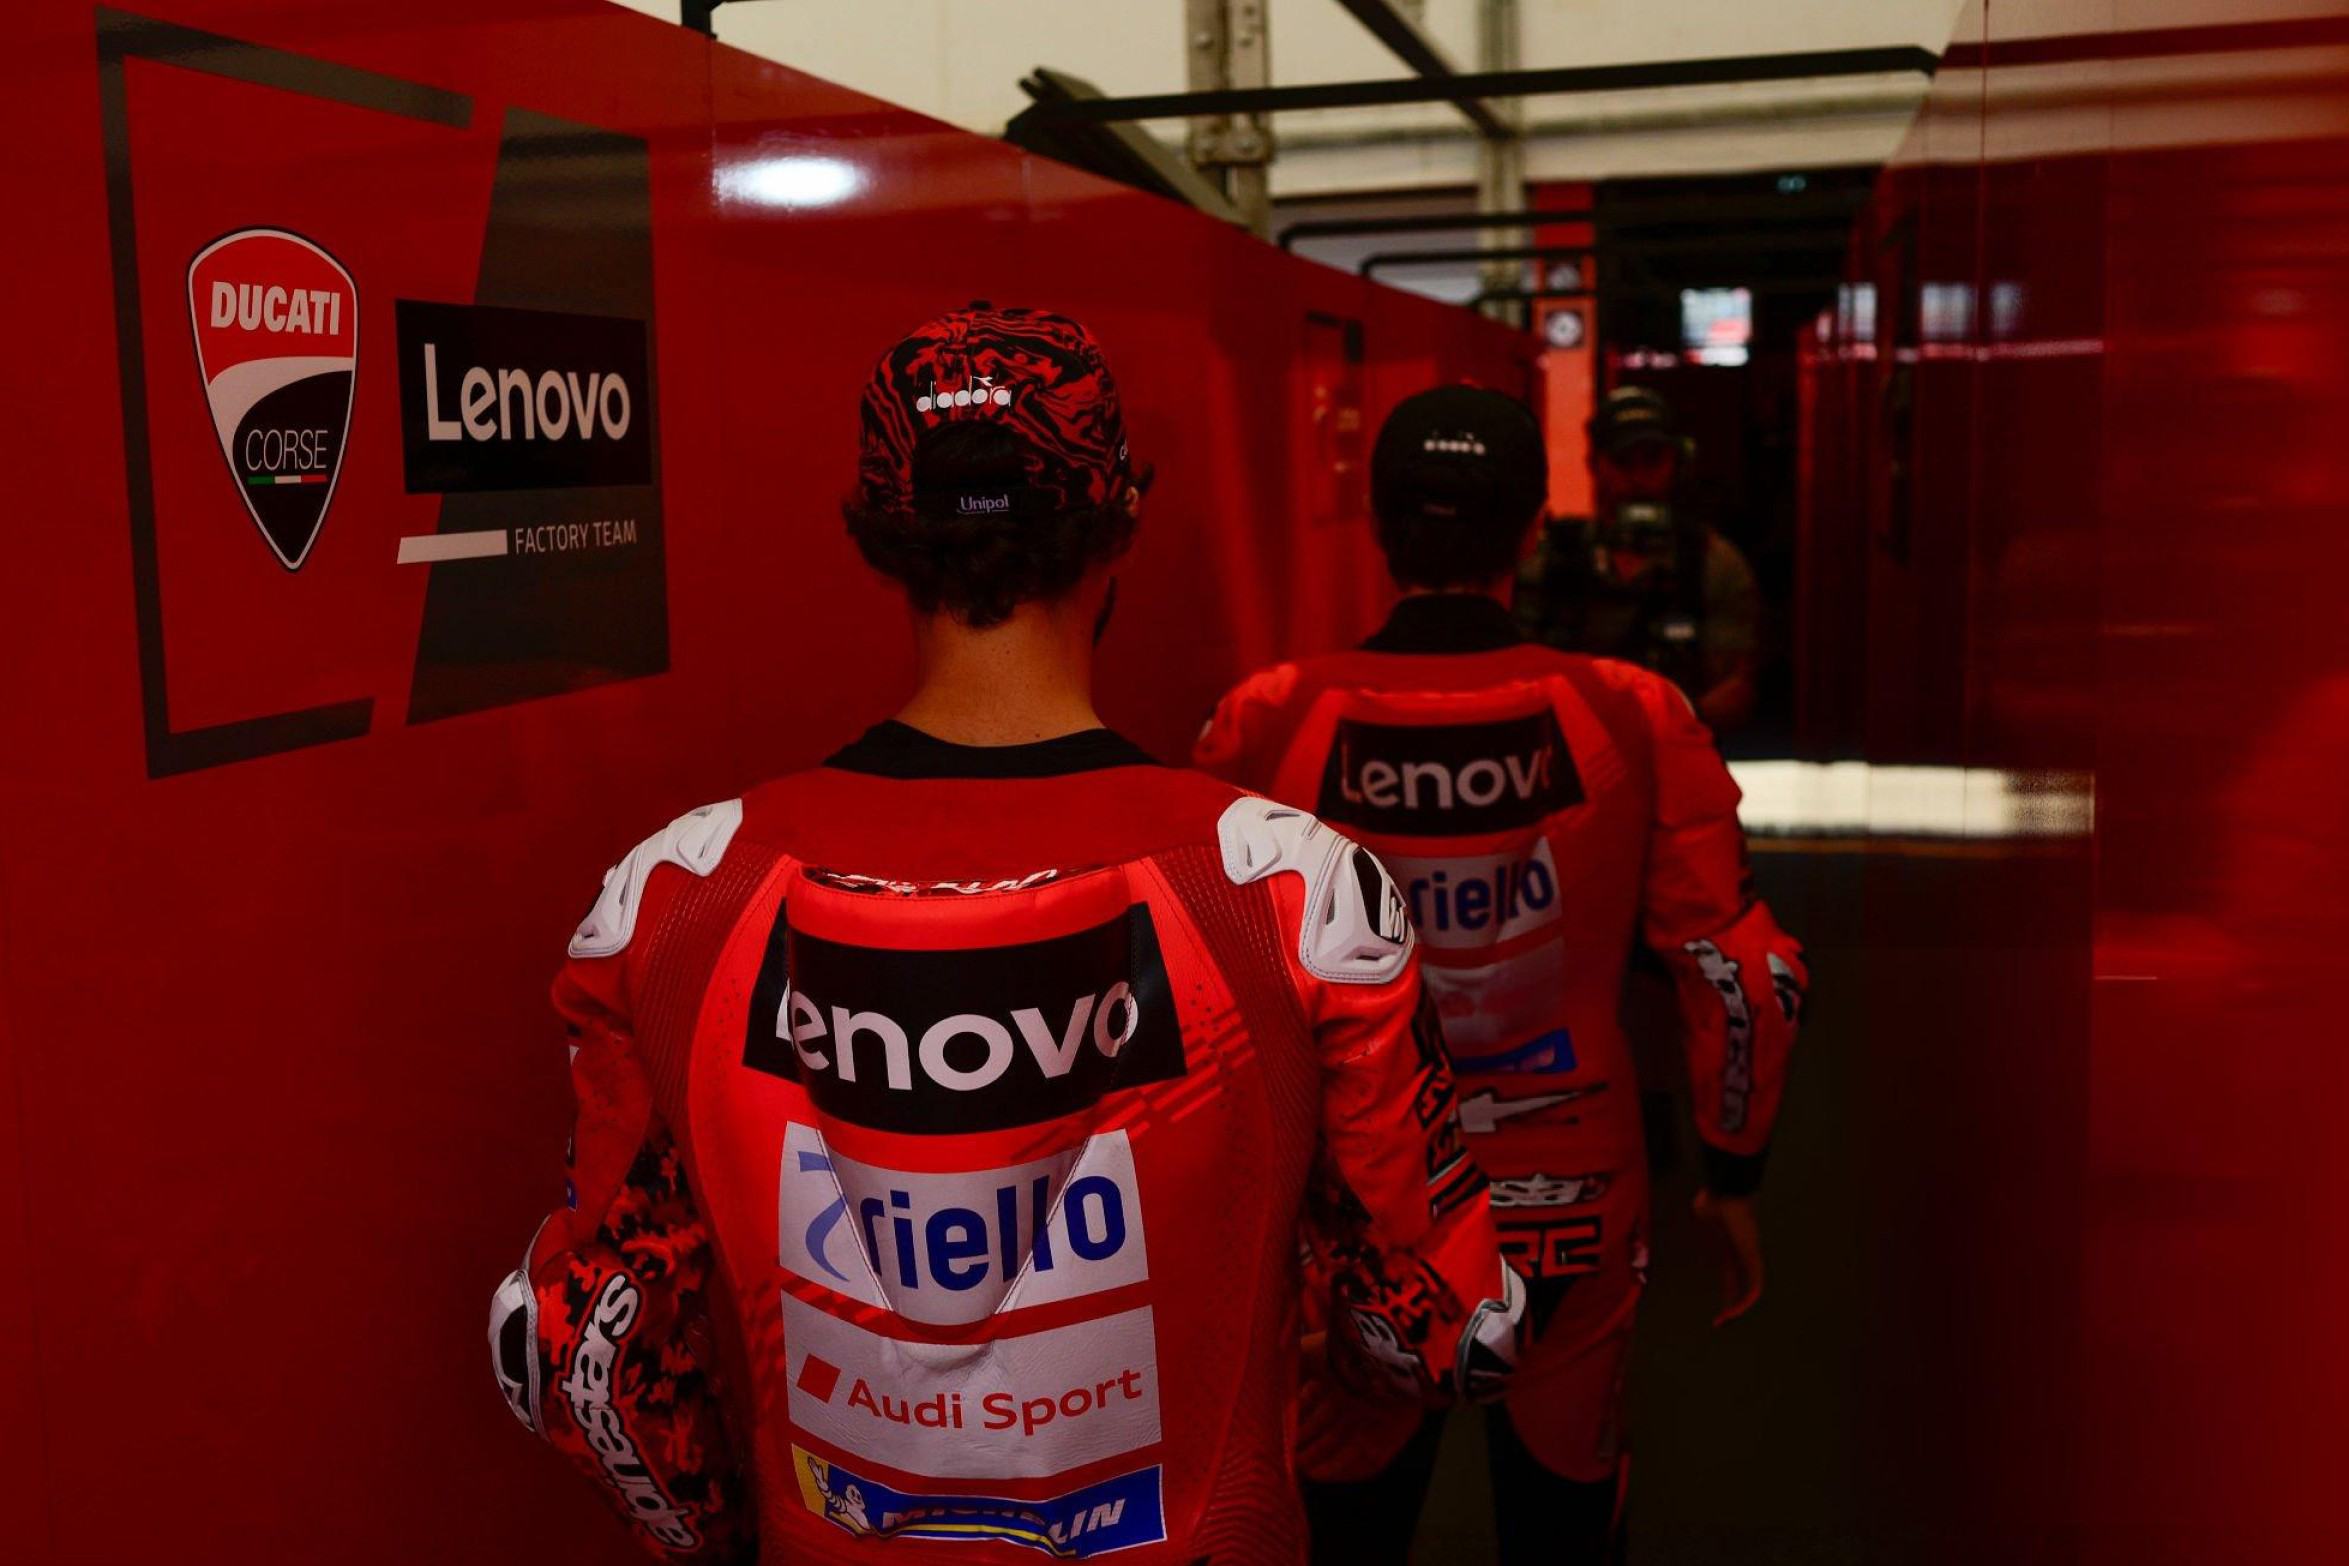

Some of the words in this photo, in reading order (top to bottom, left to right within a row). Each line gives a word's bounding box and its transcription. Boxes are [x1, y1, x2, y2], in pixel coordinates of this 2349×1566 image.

[210, 281, 341, 336] DUCATI
[424, 342, 632, 442] Lenovo
[245, 428, 329, 471] CORSE
[960, 494, 1009, 514] Unipol
[514, 524, 589, 555] FACTORY
[594, 519, 638, 548] TEAM
[859, 1175, 1127, 1292] riello
[847, 1378, 964, 1430] Audi
[982, 1369, 1143, 1436] Sport
